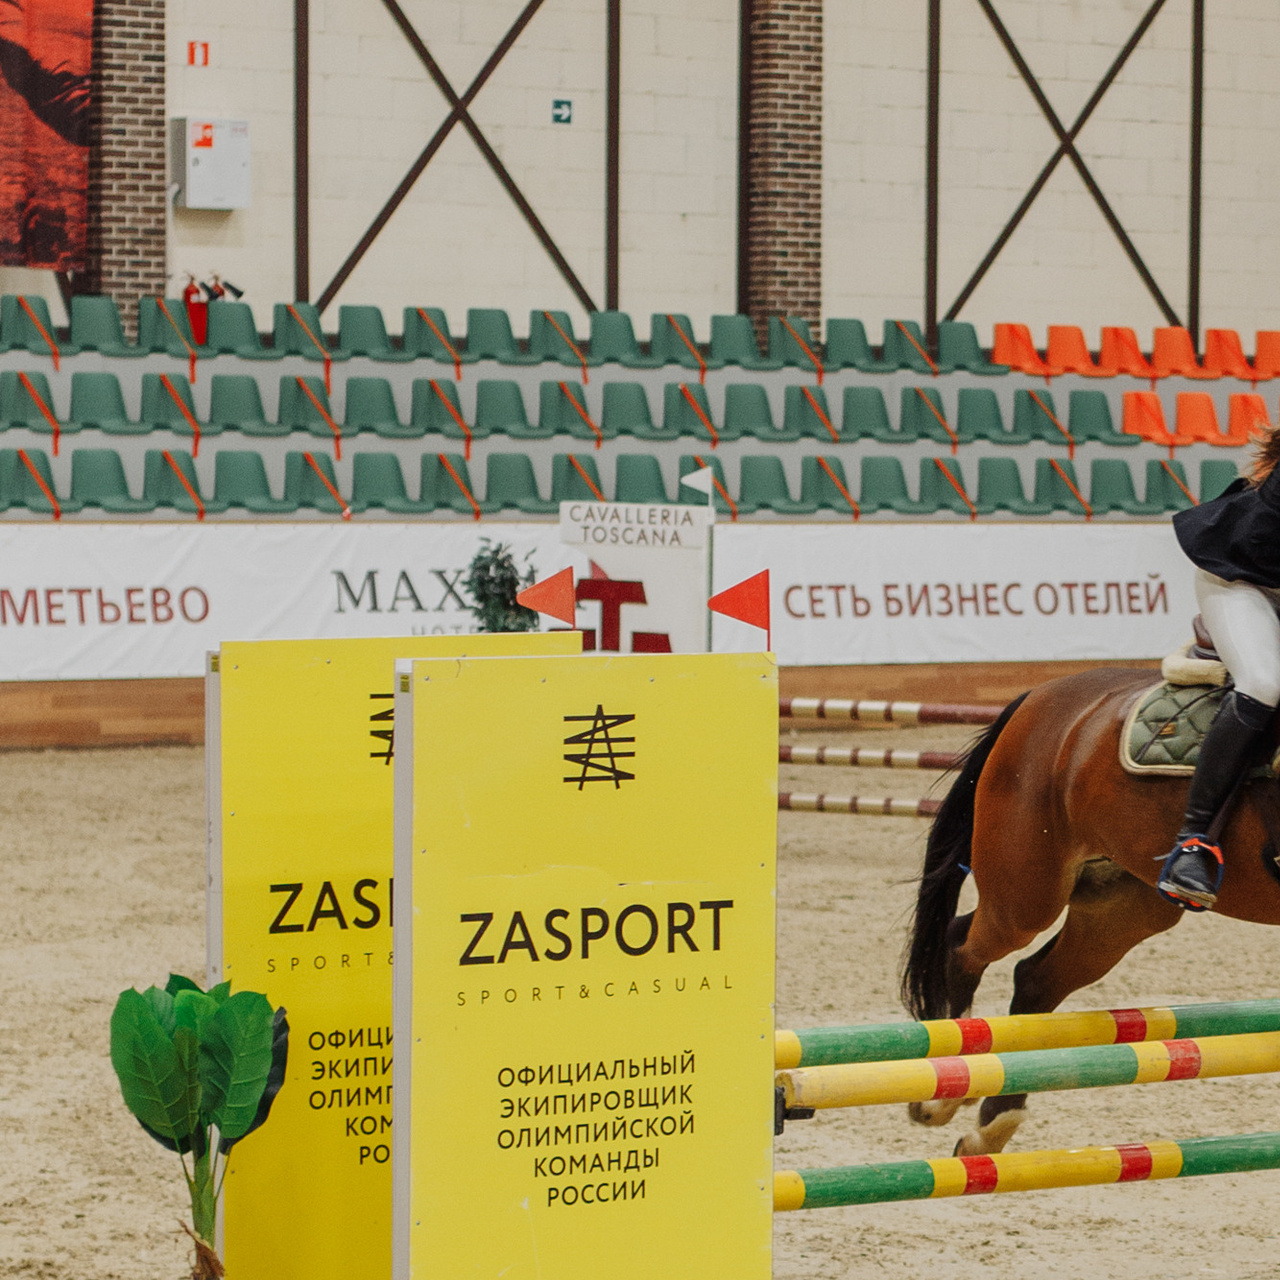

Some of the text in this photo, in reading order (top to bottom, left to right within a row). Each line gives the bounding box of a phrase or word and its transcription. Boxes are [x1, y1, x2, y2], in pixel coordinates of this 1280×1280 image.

[569, 505, 693, 526] CAVALLERIA
[580, 524, 682, 546] TOSCANA
[0, 586, 210, 626] МЕТЬЕВО
[783, 573, 1169, 619] СЕТЬ БИЗНЕС ОТЕЛЕЙ
[458, 899, 734, 967] ZASPORT
[497, 1049, 695, 1088] ОФИЦИАЛЬНЫЙ
[500, 1084, 693, 1119] ЭКИПИРОВЩИК
[497, 1114, 694, 1150] ОЛИМПИЙСКОЙ
[534, 1147, 659, 1178] КОМАНДЫ
[547, 1179, 646, 1208] РОССИИ
